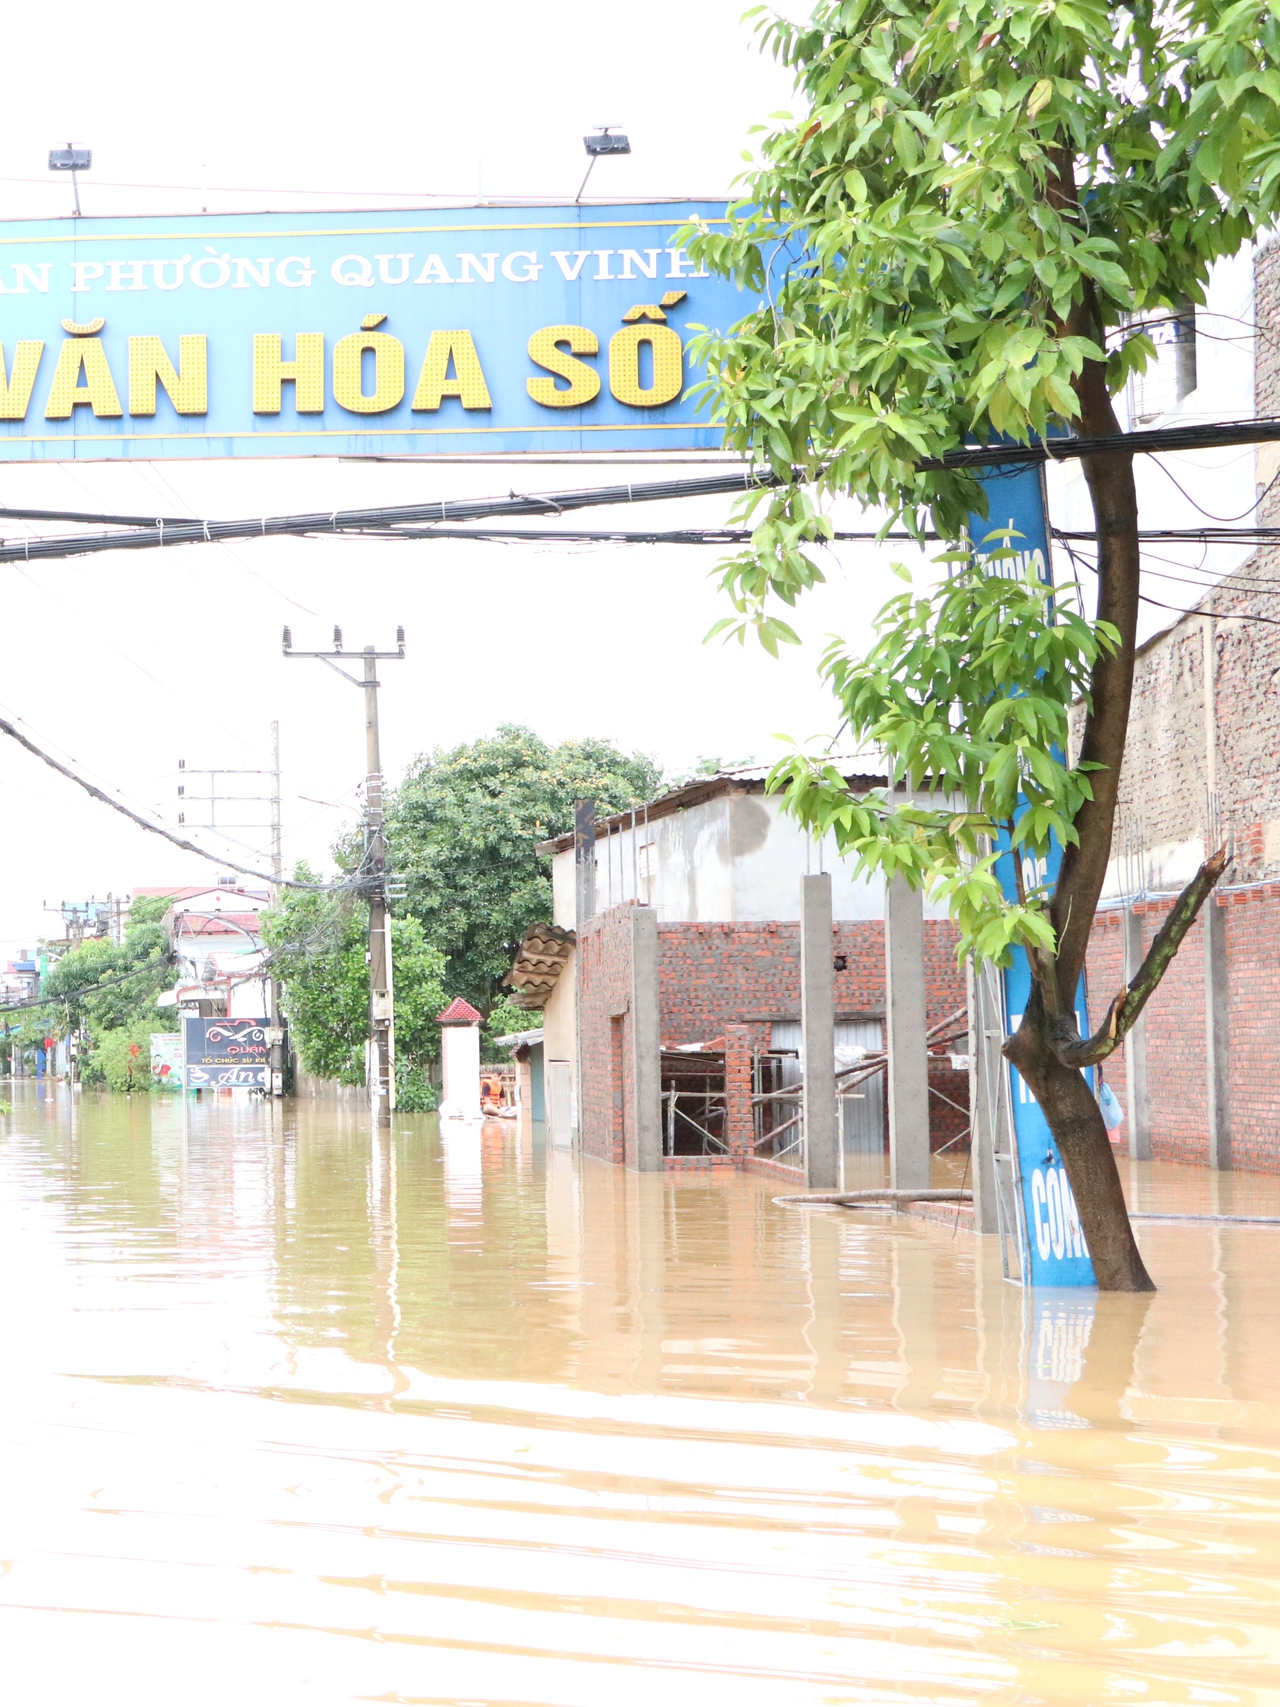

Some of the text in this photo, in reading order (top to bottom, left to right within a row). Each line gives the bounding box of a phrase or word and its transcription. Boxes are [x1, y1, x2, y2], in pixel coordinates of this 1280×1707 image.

[71, 245, 317, 292] PHƯỜNG
[331, 250, 544, 287] QUANG
[550, 247, 710, 283] VINH
[252, 313, 493, 415] HÓA
[526, 290, 689, 408] SỐ
[1031, 1148, 1090, 1262] CÔN
